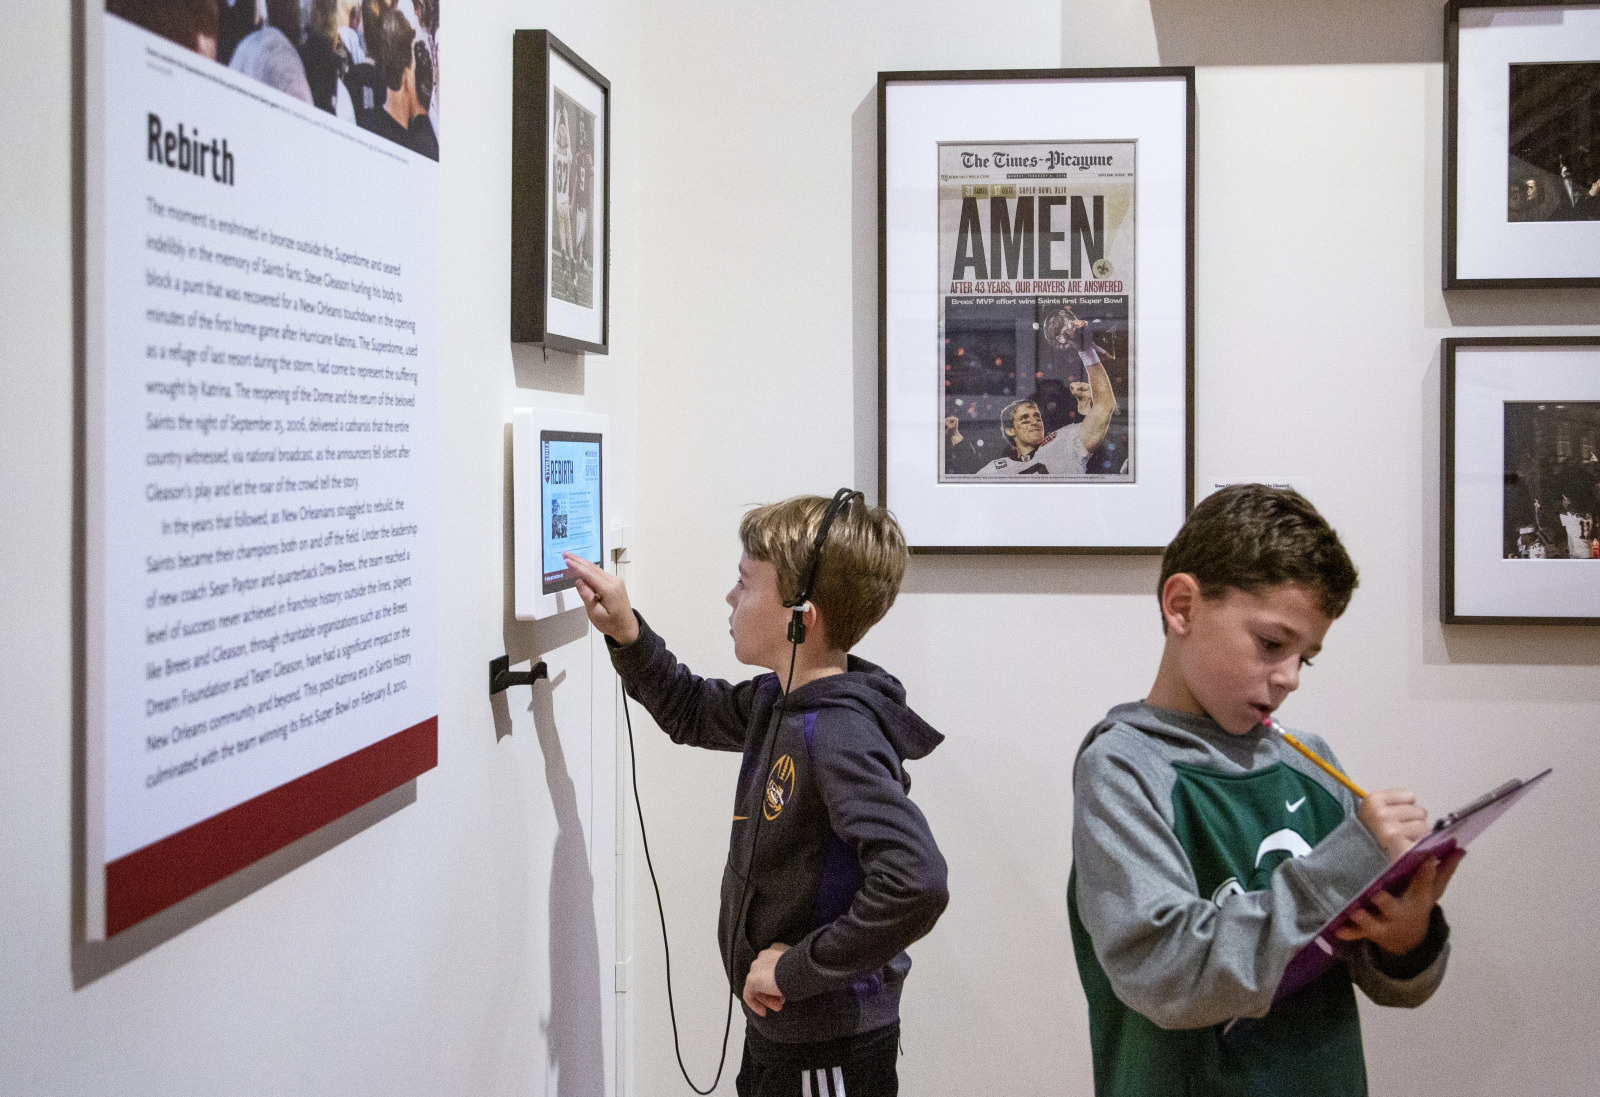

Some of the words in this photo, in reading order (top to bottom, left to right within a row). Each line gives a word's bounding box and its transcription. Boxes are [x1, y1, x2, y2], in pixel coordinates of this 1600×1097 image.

[148, 113, 234, 186] Rebirth
[961, 152, 989, 168] The
[992, 151, 1113, 171] Times-Picayune
[952, 196, 1104, 280] AMEN
[296, 240, 322, 256] outside
[334, 247, 370, 268] Superdome
[370, 259, 381, 271] and
[382, 263, 400, 276] seared
[304, 268, 322, 285] Steve
[323, 272, 349, 290] Gleason
[350, 280, 371, 300] hurling
[382, 286, 395, 303] body
[950, 281, 973, 294] AFTER
[975, 281, 985, 293] 43
[987, 281, 1013, 295] YEARS,
[1015, 281, 1031, 293] OUR
[1033, 281, 1065, 293] PRAYERS
[1067, 281, 1082, 293] ARE
[1084, 280, 1123, 292] ANSWERED
[1079, 297, 1102, 305] Super
[299, 298, 316, 313] New
[316, 300, 342, 318] Orleans
[343, 308, 376, 323] touchdown
[394, 318, 415, 334] opening
[299, 329, 332, 345] Hurricane
[405, 344, 417, 356] used
[316, 360, 329, 374] had
[330, 364, 348, 375] come
[357, 367, 384, 378] represent
[395, 366, 418, 385] suffering
[313, 387, 334, 403] Dome
[334, 390, 347, 404] and
[359, 394, 376, 405] return
[394, 394, 415, 407] beloved
[308, 417, 338, 432] delivered
[344, 419, 370, 432] catharsis
[372, 419, 383, 432] that
[394, 421, 409, 432] entire
[336, 449, 371, 460] announcers
[382, 446, 397, 458] silent
[398, 444, 410, 458] after
[298, 476, 319, 491] crowd
[551, 460, 574, 484] REBIRTH
[298, 506, 335, 520] Orleanians
[336, 502, 365, 519] struggled
[309, 534, 322, 549] and
[361, 528, 379, 541] Under
[390, 523, 417, 536] leadership
[276, 566, 318, 586] quarterback
[319, 562, 336, 576] Drew
[368, 555, 383, 567] team
[384, 549, 405, 564] reached
[286, 596, 318, 612] franchise
[344, 584, 366, 600] outside
[393, 576, 411, 590] players
[282, 625, 315, 644] charitable
[316, 616, 358, 637] organizations
[360, 609, 373, 624] such
[392, 602, 407, 615] Brees
[306, 654, 322, 666] have
[322, 646, 335, 661] had
[342, 638, 372, 659] significant
[373, 632, 392, 646] impact
[304, 682, 318, 696] This
[318, 671, 357, 694] post-Katrina
[375, 659, 392, 673] Saints
[393, 653, 411, 666] history
[299, 713, 313, 728] first
[314, 707, 333, 723] Super
[335, 700, 350, 715] Bowl
[361, 688, 385, 704] February
